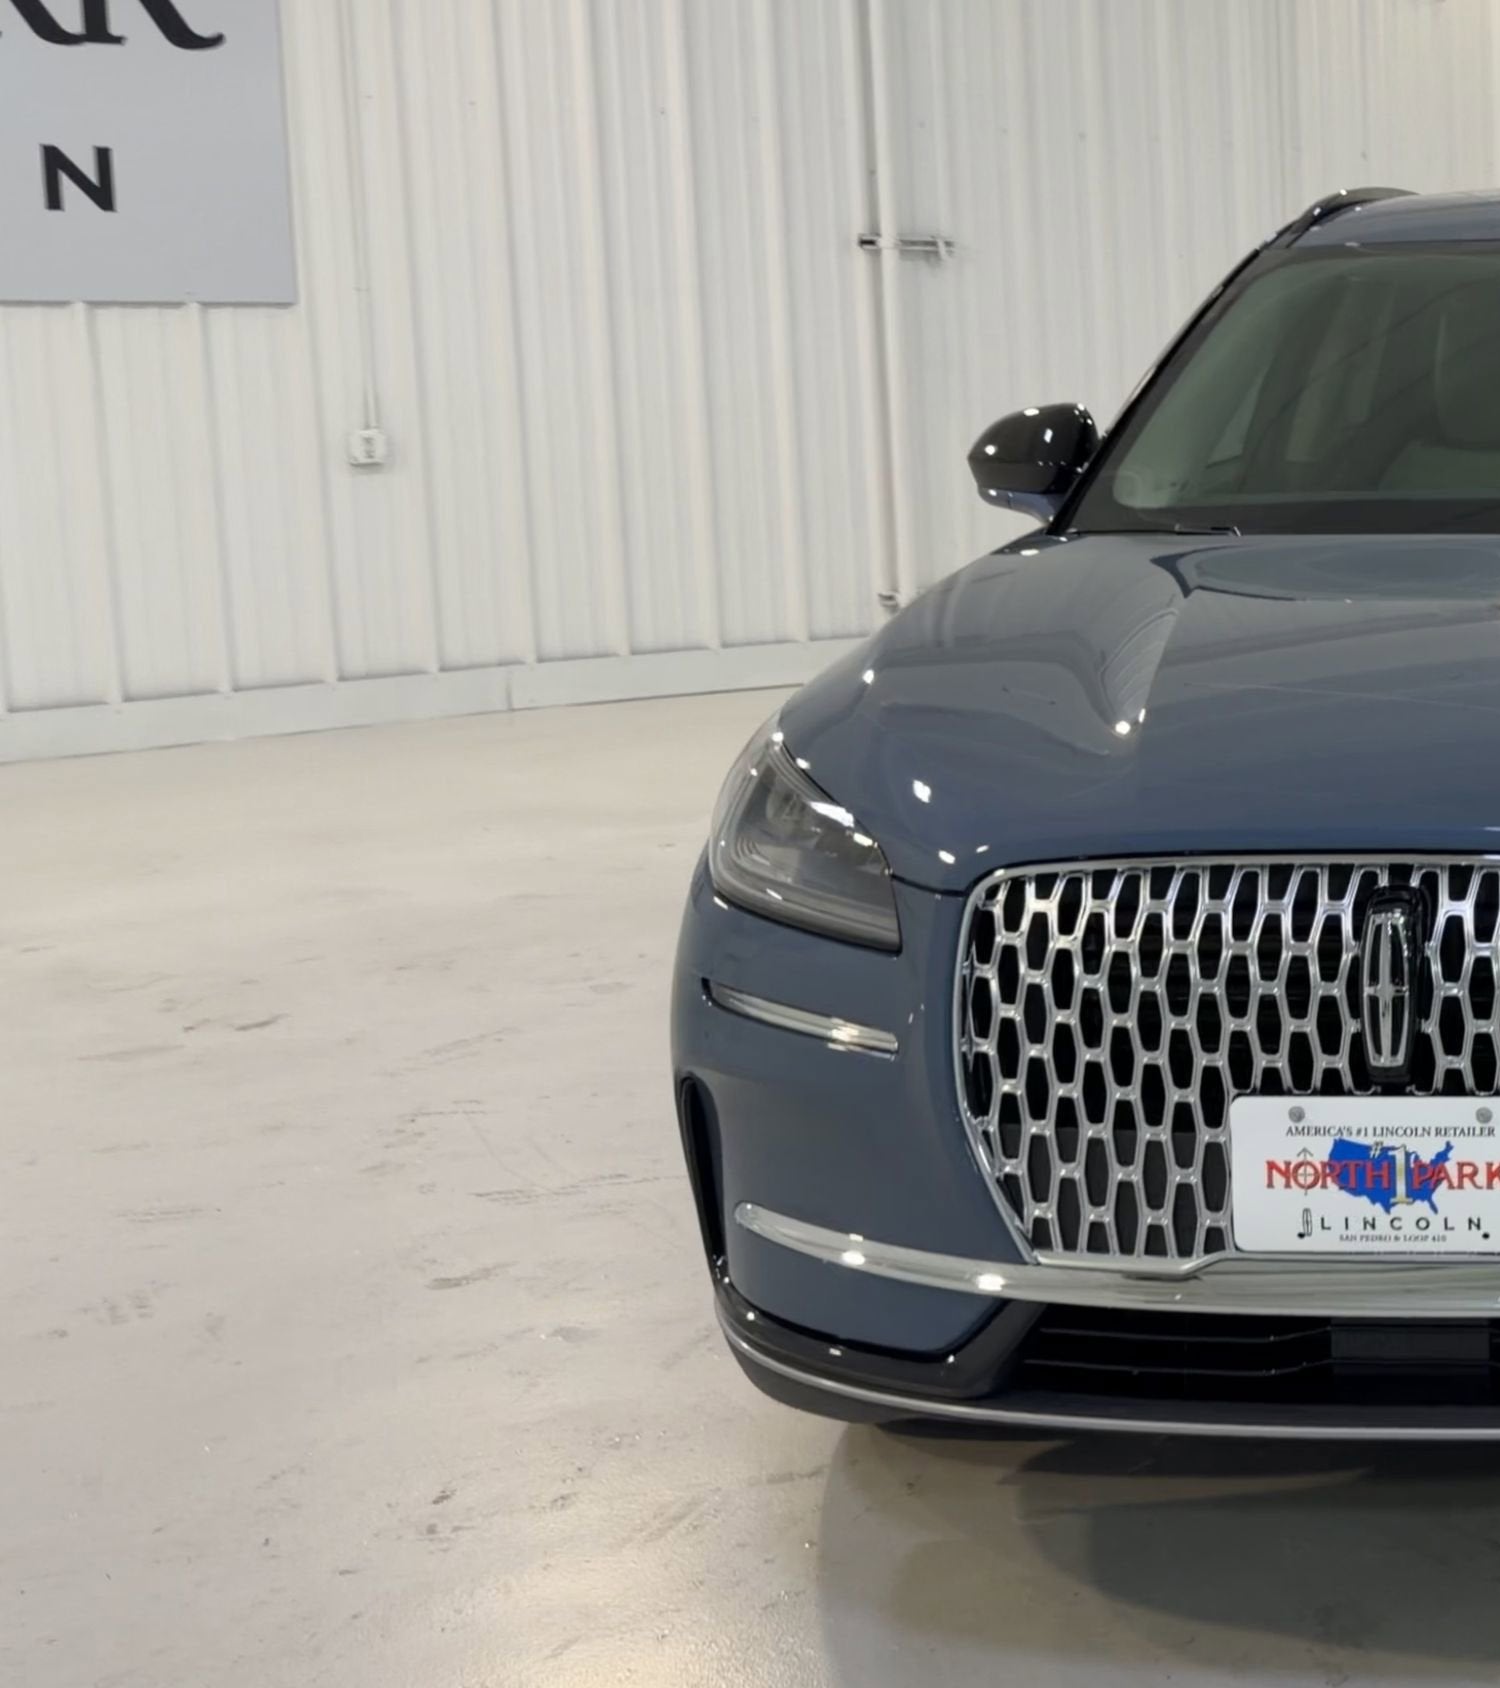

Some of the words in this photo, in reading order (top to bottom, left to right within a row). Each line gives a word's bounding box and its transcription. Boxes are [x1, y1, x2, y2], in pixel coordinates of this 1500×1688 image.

[40, 143, 117, 213] N
[1286, 1125, 1353, 1138] AMERICA'S
[1355, 1126, 1369, 1138] #1
[1372, 1125, 1432, 1138] LINCOLN
[1434, 1126, 1497, 1138] RETAILER
[1265, 1159, 1391, 1191] NORTH
[1320, 1216, 1482, 1231] LINCOLN
[1339, 1233, 1358, 1243] SAN
[1360, 1233, 1393, 1243] PEDRO
[1403, 1233, 1430, 1243] LOOP
